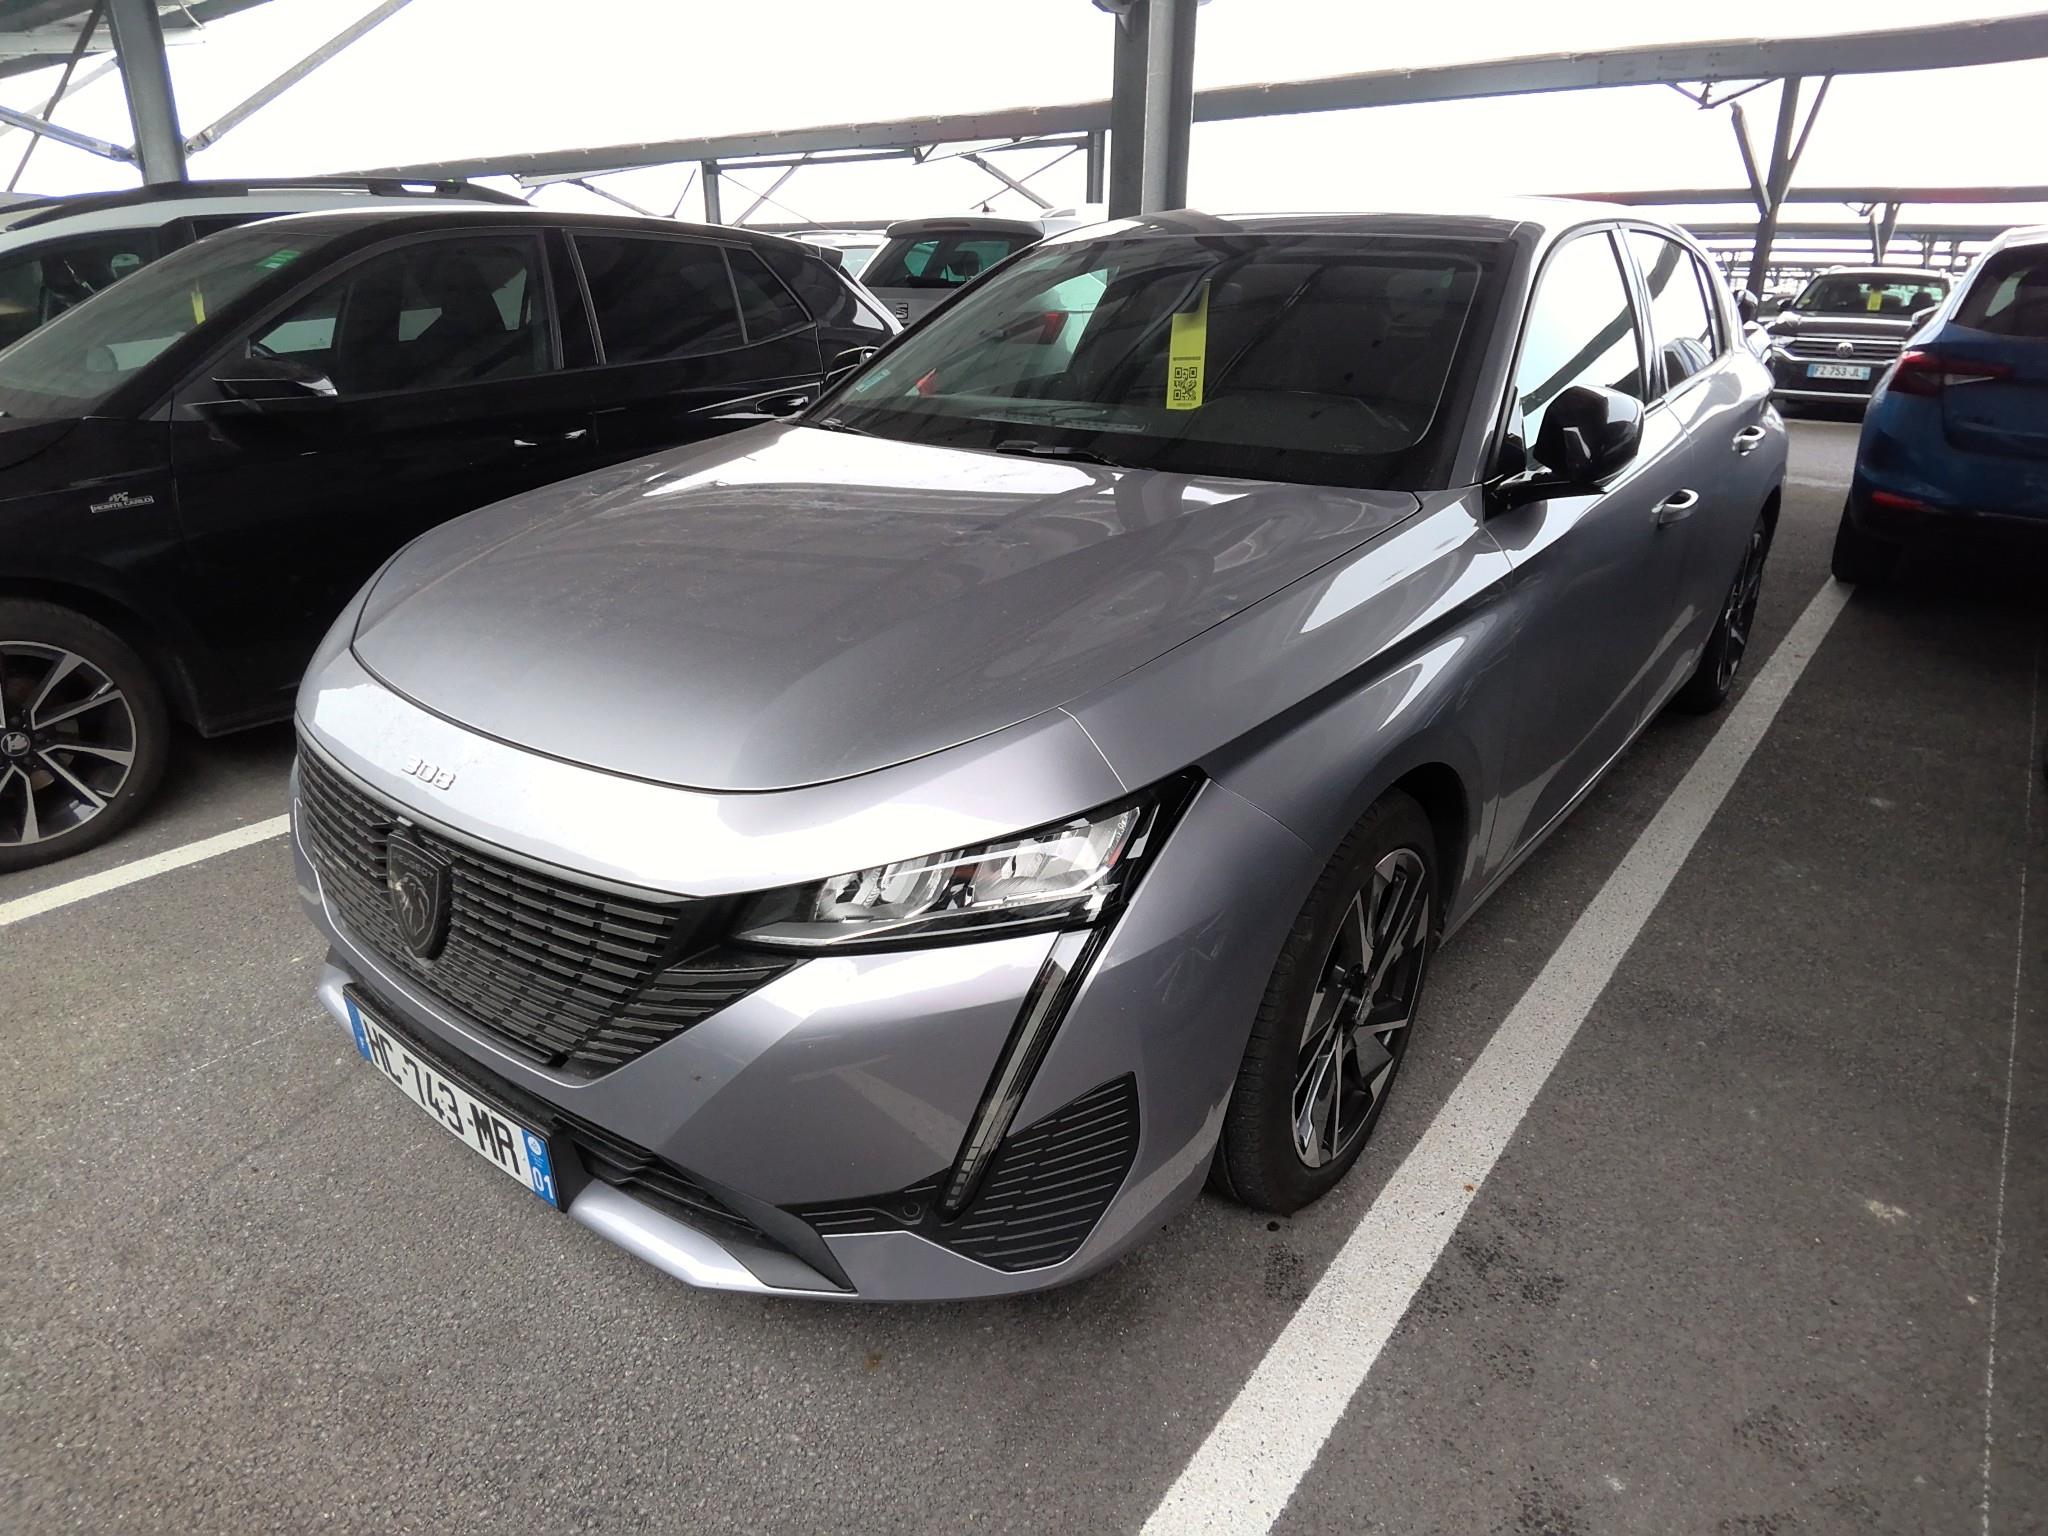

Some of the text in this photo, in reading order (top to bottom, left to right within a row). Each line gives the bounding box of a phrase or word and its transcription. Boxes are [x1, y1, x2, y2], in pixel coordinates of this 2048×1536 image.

[401, 757, 457, 791] 308
[392, 853, 434, 878] PEUGEOT
[363, 1019, 521, 1175] HC-743-MR
[532, 1166, 554, 1199] 01
